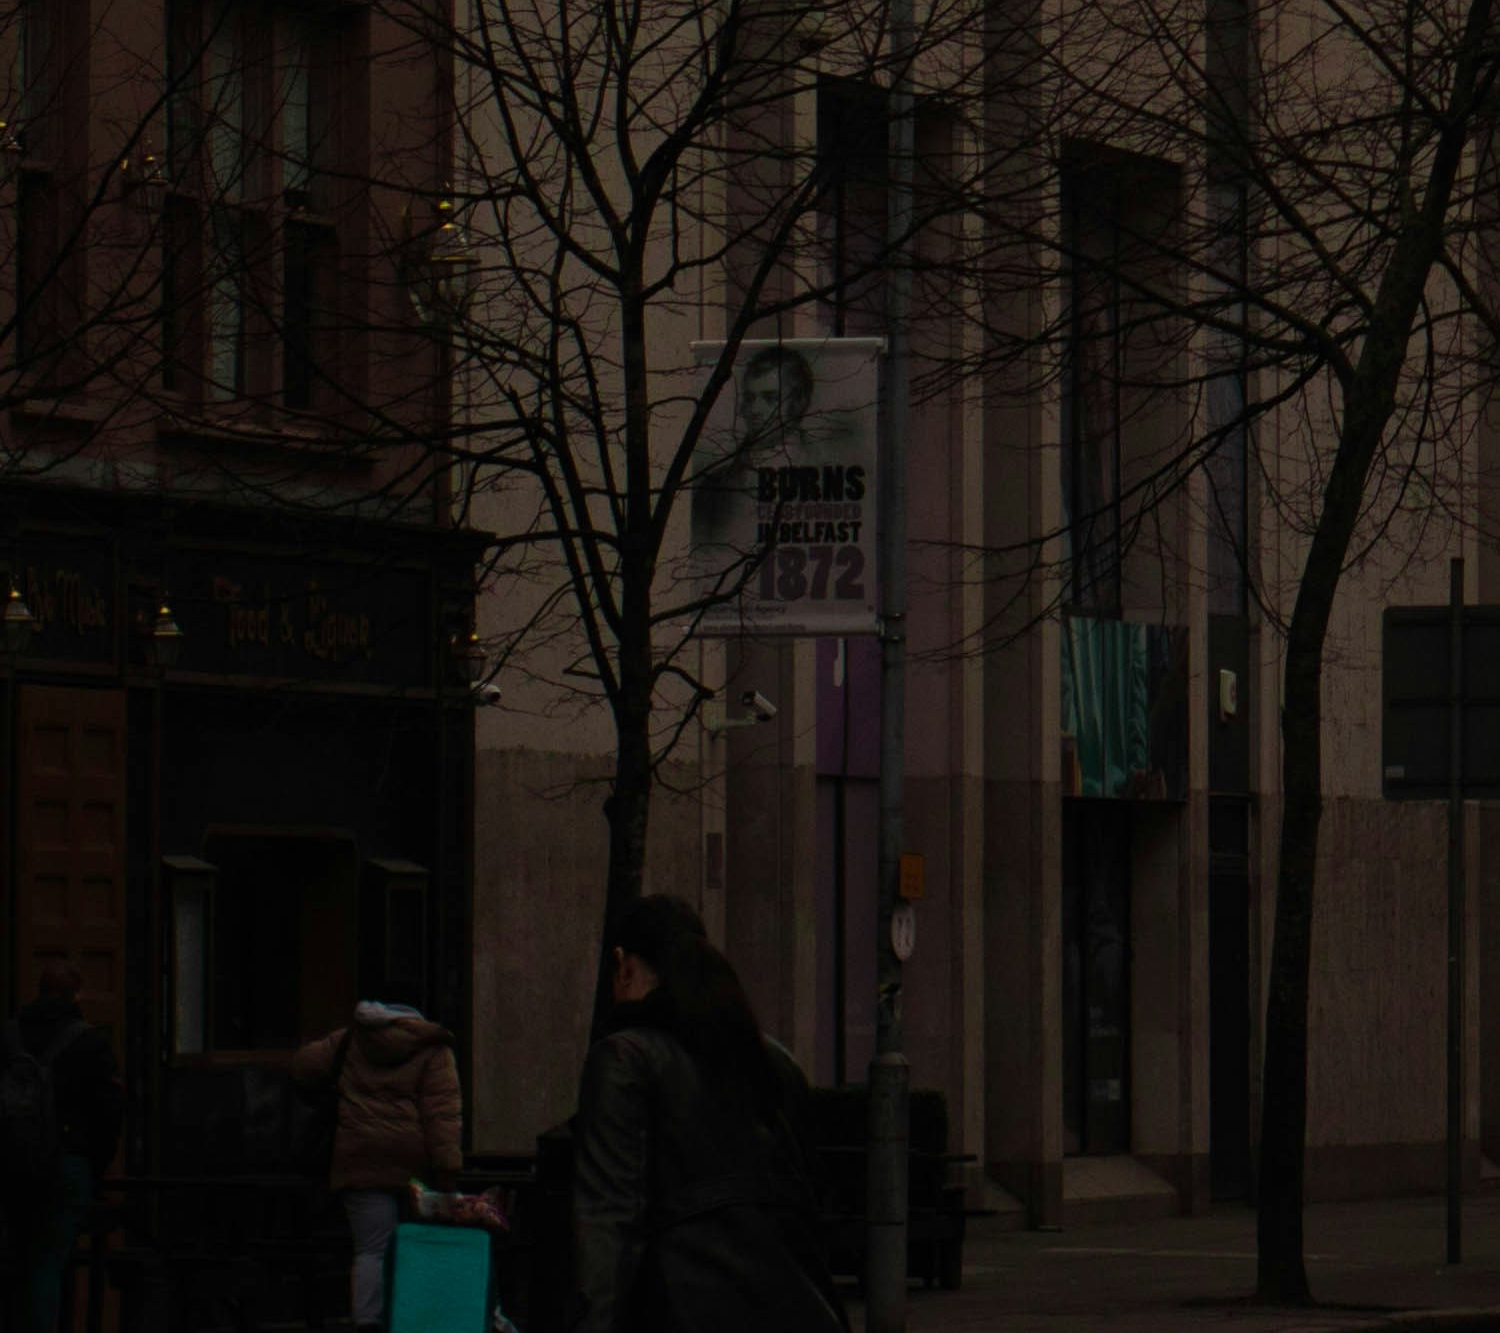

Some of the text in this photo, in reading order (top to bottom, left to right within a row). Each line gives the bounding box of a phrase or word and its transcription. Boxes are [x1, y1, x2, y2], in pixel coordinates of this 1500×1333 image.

[758, 465, 866, 501] BURNS
[780, 521, 862, 543] BELFAST
[760, 545, 865, 600] 1872
